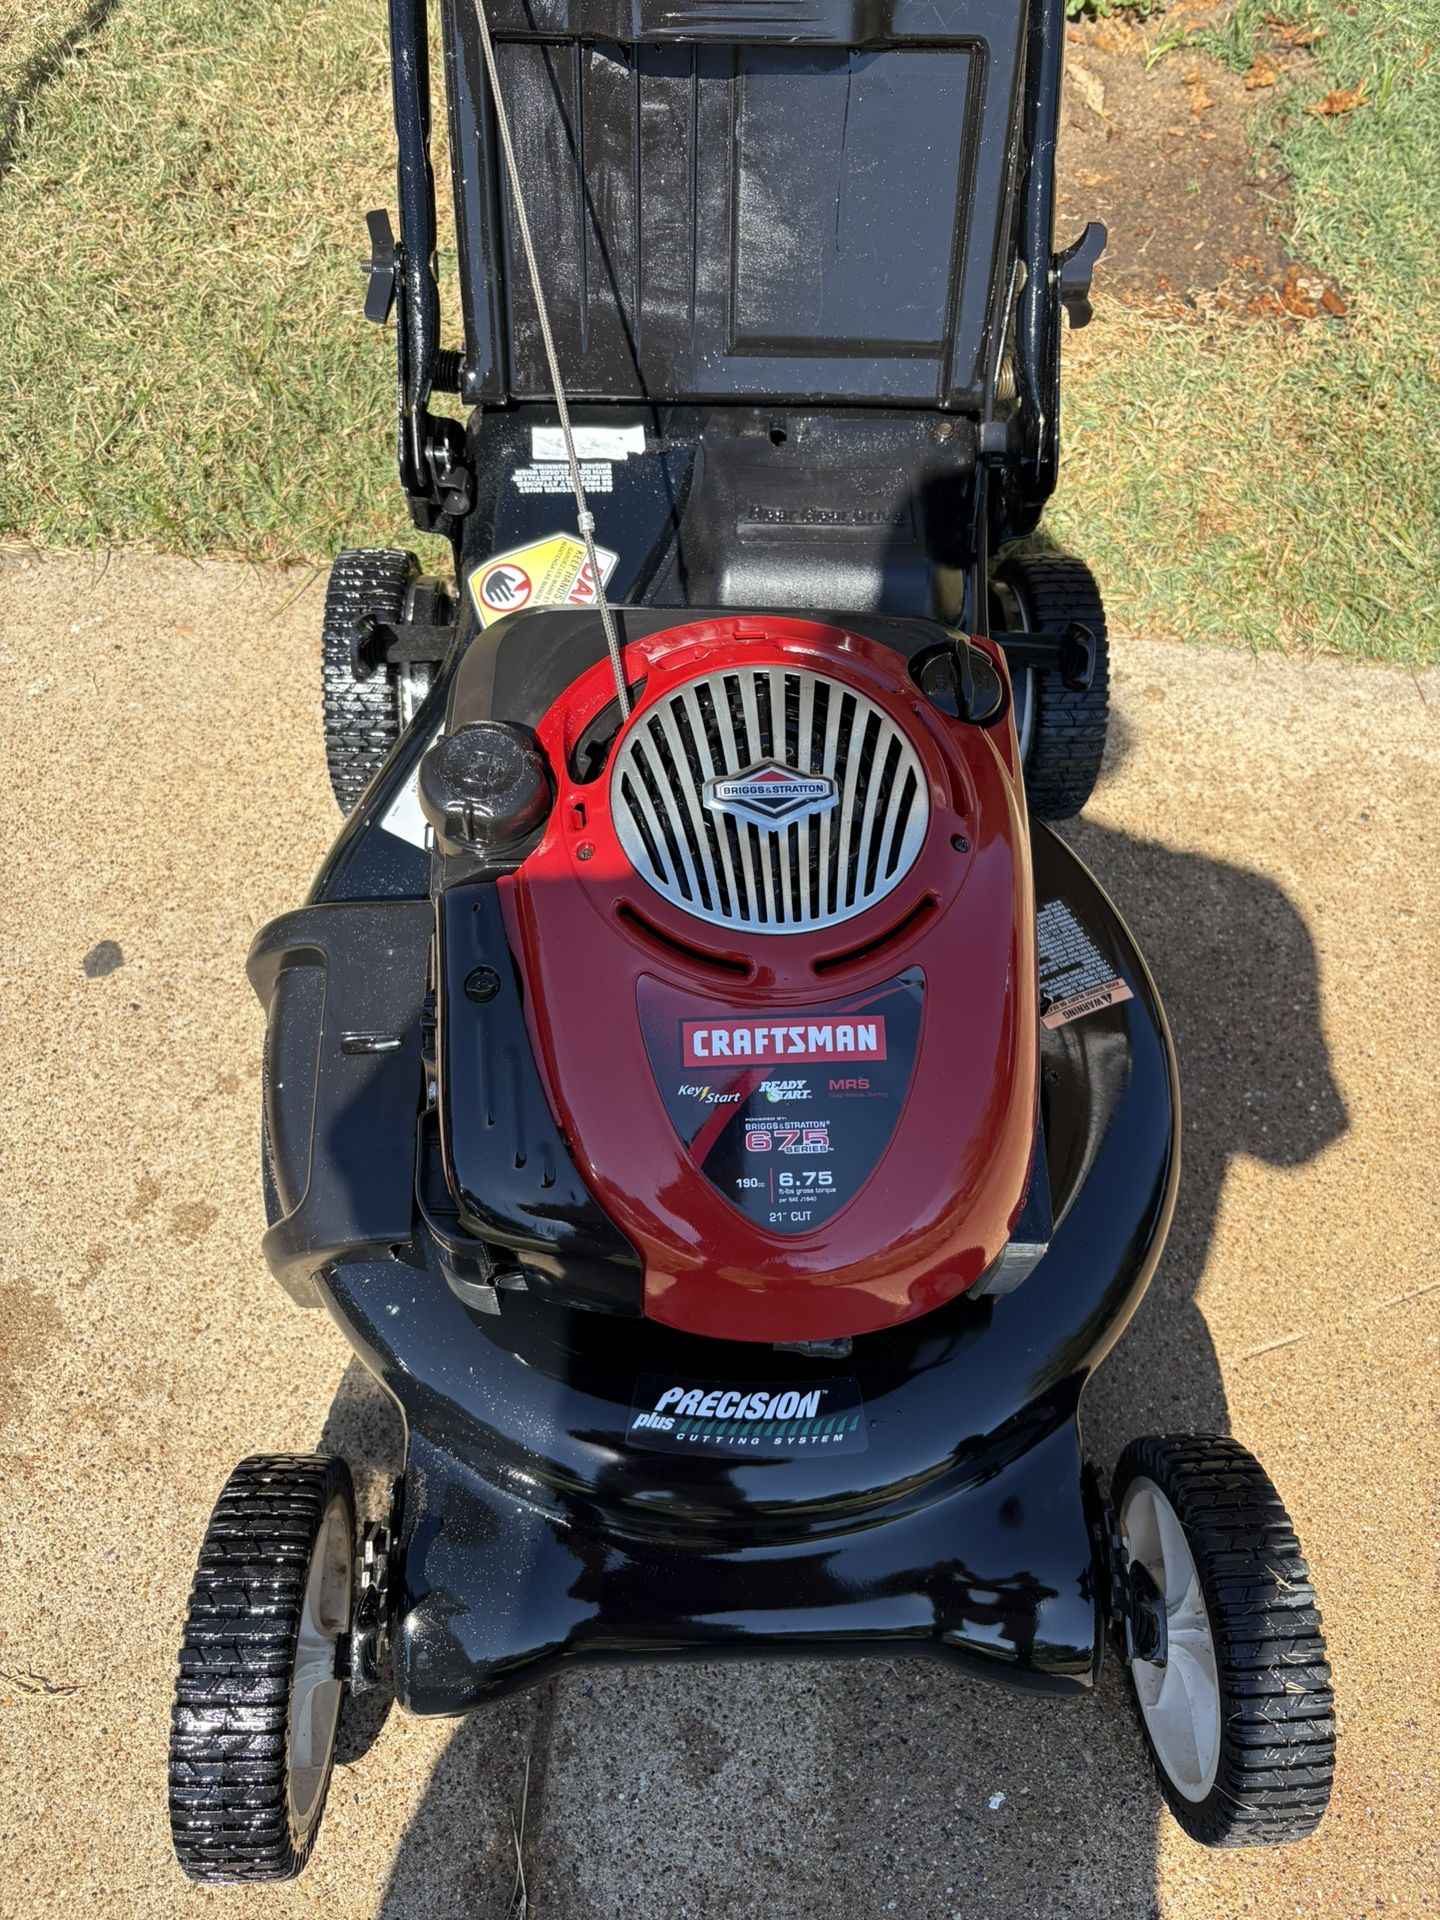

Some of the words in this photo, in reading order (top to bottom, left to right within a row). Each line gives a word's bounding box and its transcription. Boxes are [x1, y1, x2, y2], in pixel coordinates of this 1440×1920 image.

[569, 549, 585, 571] KEEP
[554, 571, 574, 600] HANDS
[1062, 998, 1104, 1019] WARNING
[693, 1024, 877, 1057] CRAFTSMAN
[759, 1080, 807, 1092] READY
[828, 1078, 870, 1090] MRS
[677, 1084, 703, 1097] Key
[705, 1092, 741, 1104] Start
[745, 1128, 829, 1152] 675
[785, 1145, 828, 1154] SERIES
[779, 1171, 833, 1187] 6.75
[796, 1188, 814, 1196] gross
[815, 1187, 837, 1195] torque
[791, 1211, 812, 1222] CUT
[632, 1413, 676, 1431] plus
[676, 1433, 760, 1445] CUTTING
[774, 1433, 844, 1445] SYSTEM
